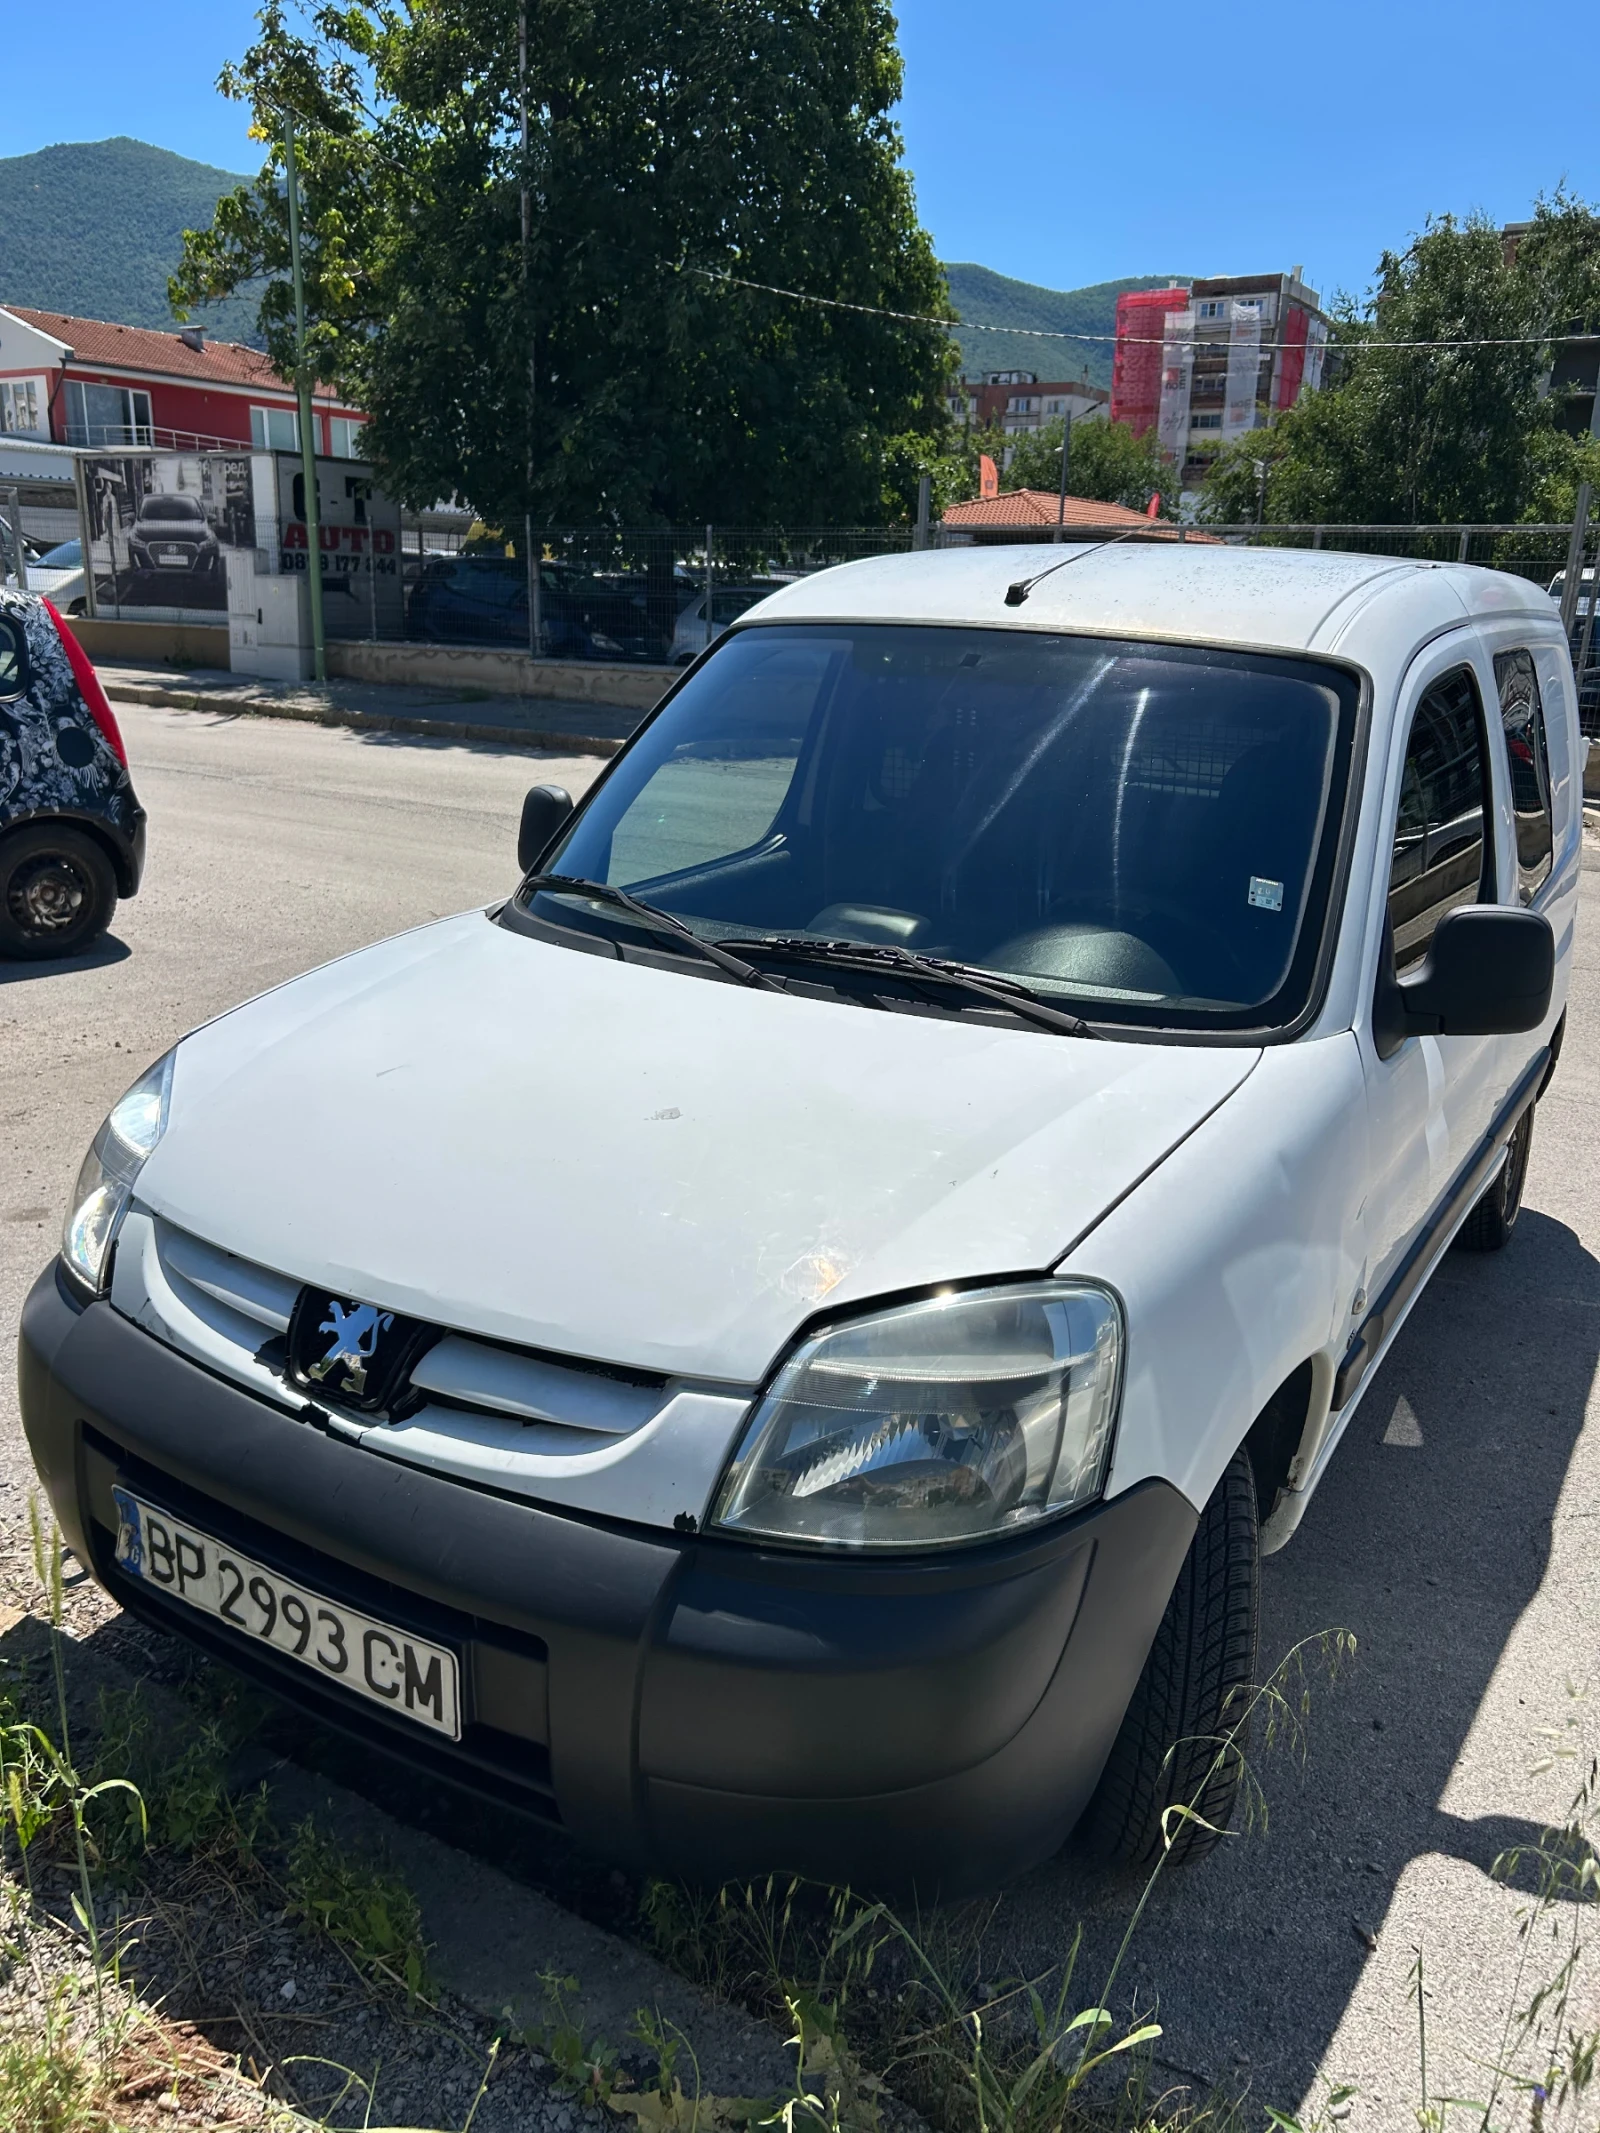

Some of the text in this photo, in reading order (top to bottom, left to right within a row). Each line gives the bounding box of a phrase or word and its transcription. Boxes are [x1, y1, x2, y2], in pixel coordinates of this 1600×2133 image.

[283, 523, 396, 554] AUTO
[281, 552, 329, 571] 089
[335, 555, 361, 572] 177
[146, 1516, 443, 1723] BP 2993 CM
